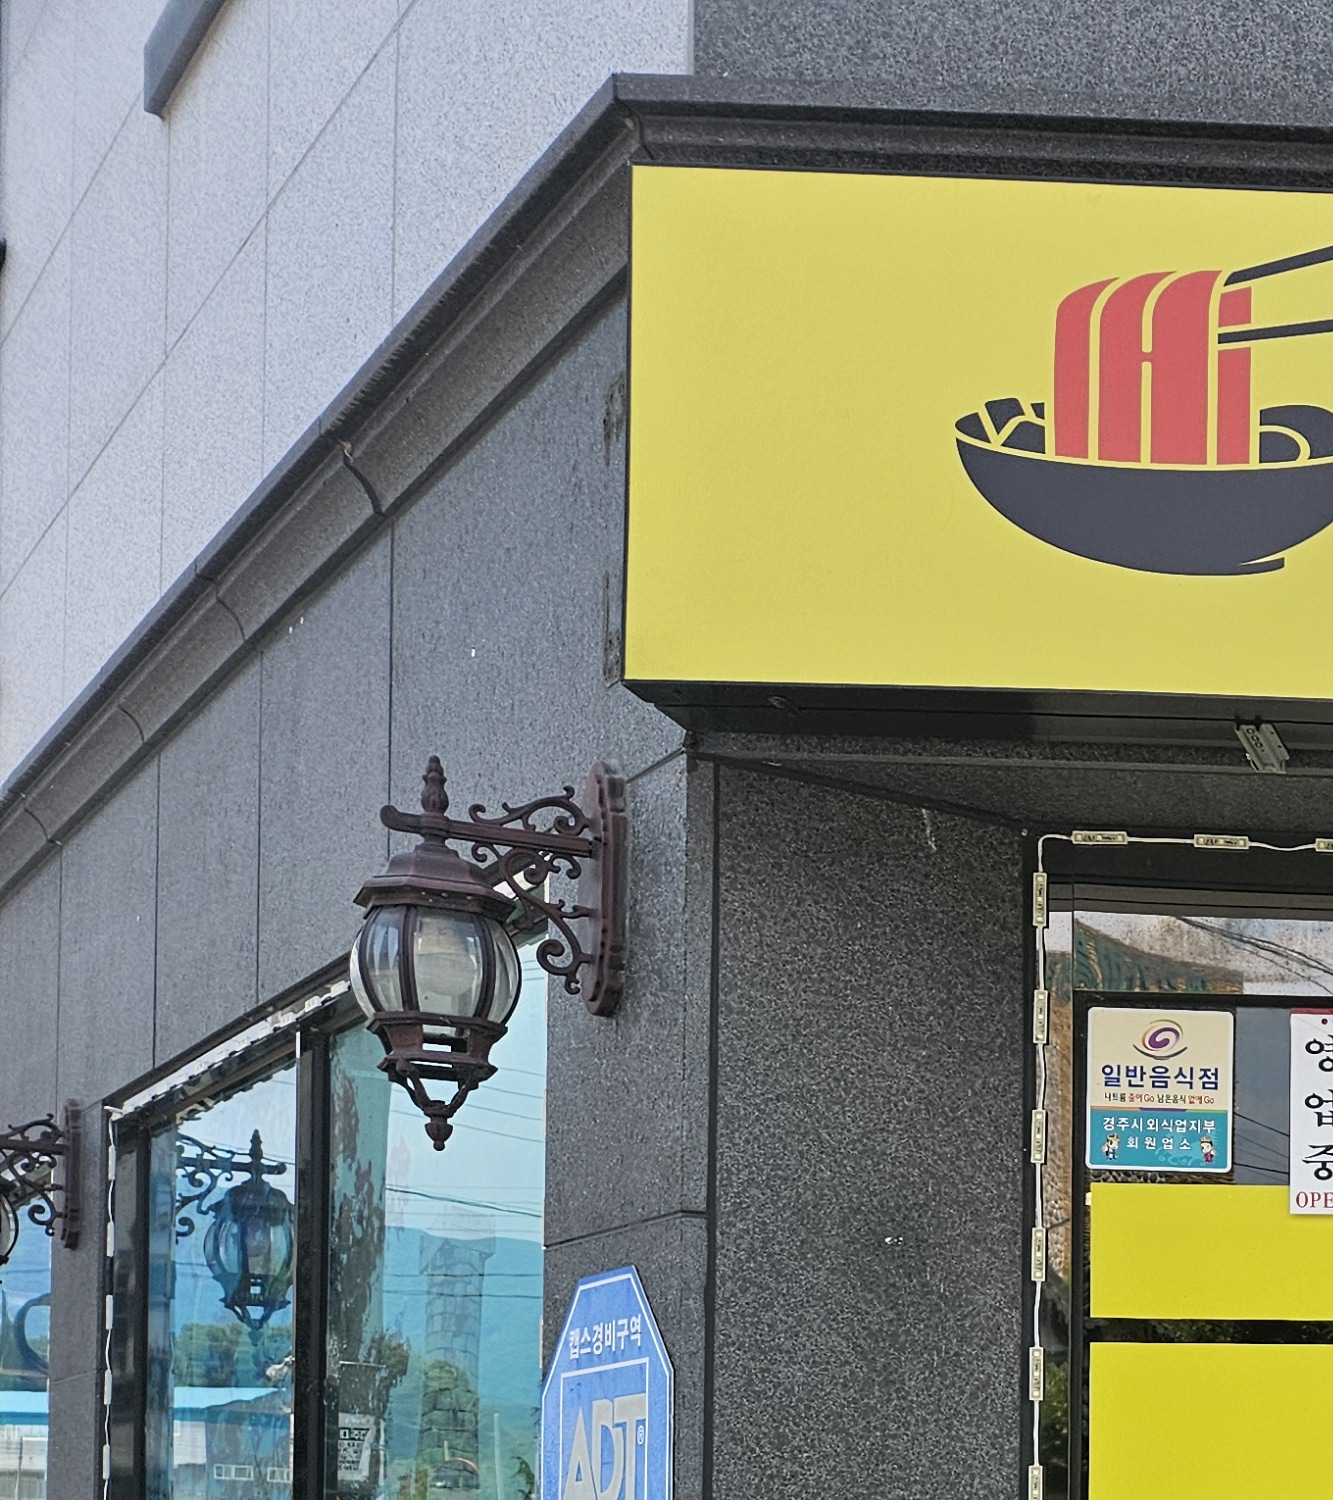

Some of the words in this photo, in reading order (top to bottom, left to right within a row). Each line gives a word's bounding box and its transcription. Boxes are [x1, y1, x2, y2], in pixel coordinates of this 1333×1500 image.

[1101, 1064, 1219, 1090] 일반음식점
[1102, 1117, 1143, 1132] 경주시
[1146, 1117, 1217, 1134] 외식업지부
[1126, 1136, 1192, 1151] 회원업소
[568, 1313, 642, 1360] 캡스경비구역
